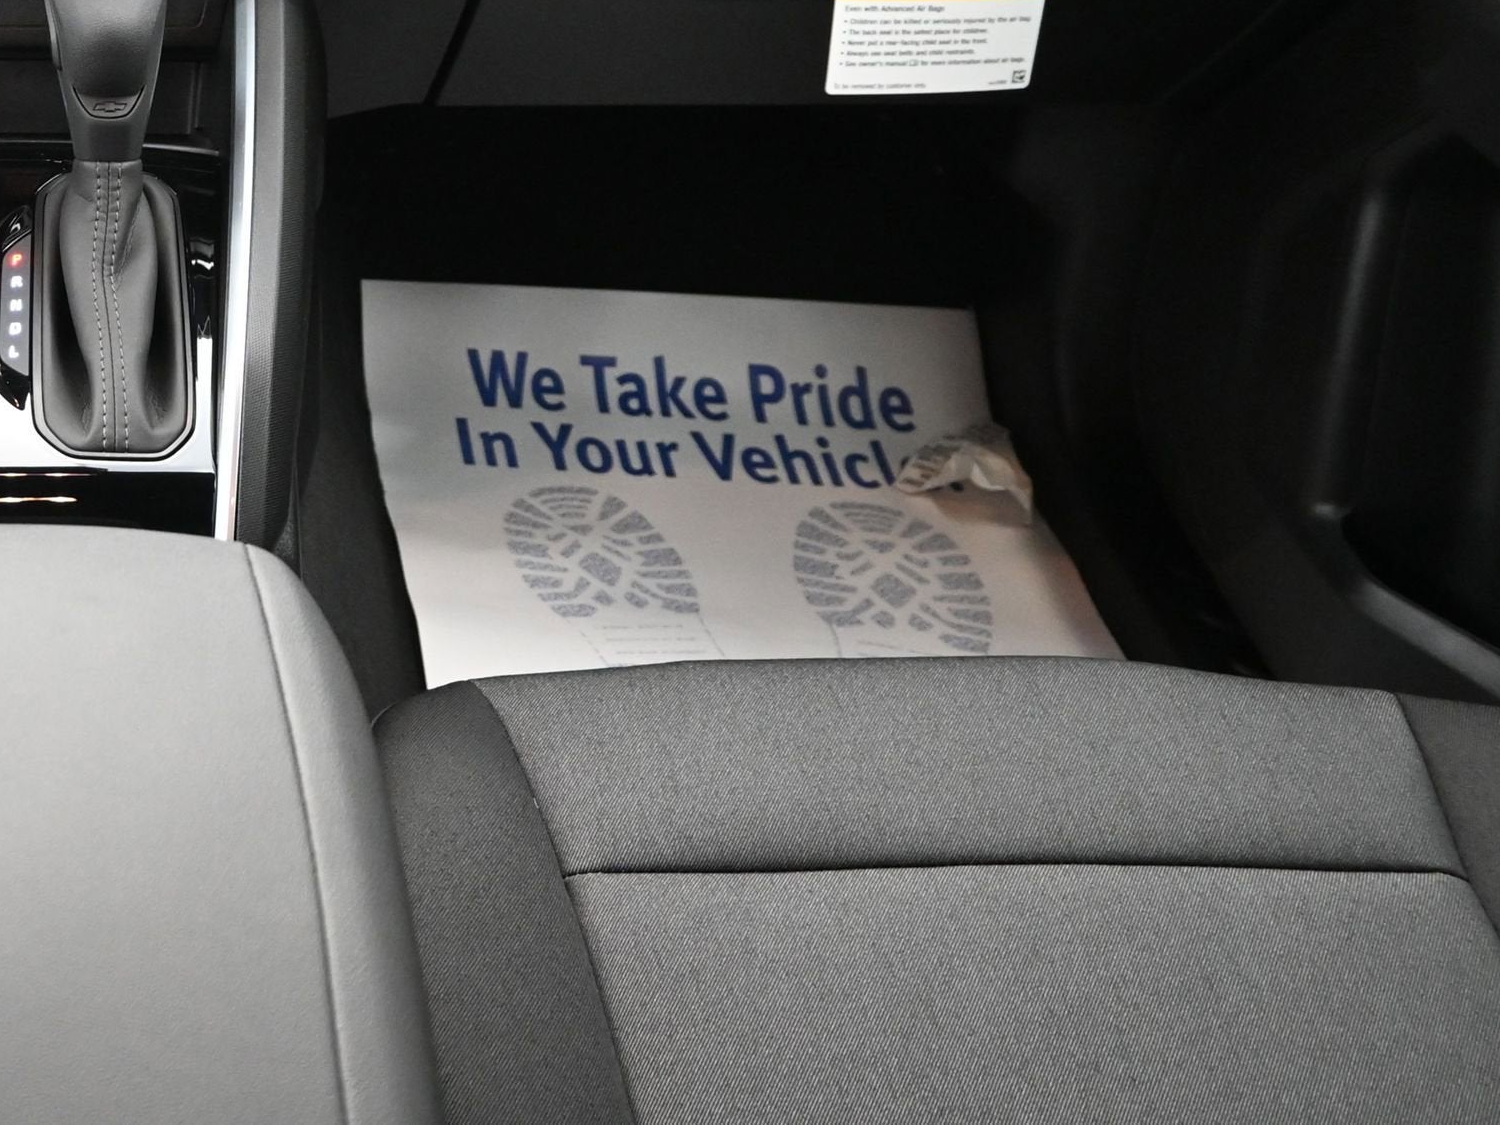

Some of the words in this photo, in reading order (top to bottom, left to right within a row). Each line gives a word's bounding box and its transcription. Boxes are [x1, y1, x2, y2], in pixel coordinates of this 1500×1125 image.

[928, 5, 945, 13] Bags
[11, 254, 23, 266] P
[10, 276, 23, 288] R
[10, 299, 23, 312] N
[8, 322, 22, 335] D
[8, 345, 20, 358] L
[467, 348, 566, 412] We
[579, 355, 729, 423] Take
[747, 363, 915, 433] Pride
[455, 417, 519, 469] In
[530, 421, 681, 478] Your
[690, 430, 920, 489] Vehicl
